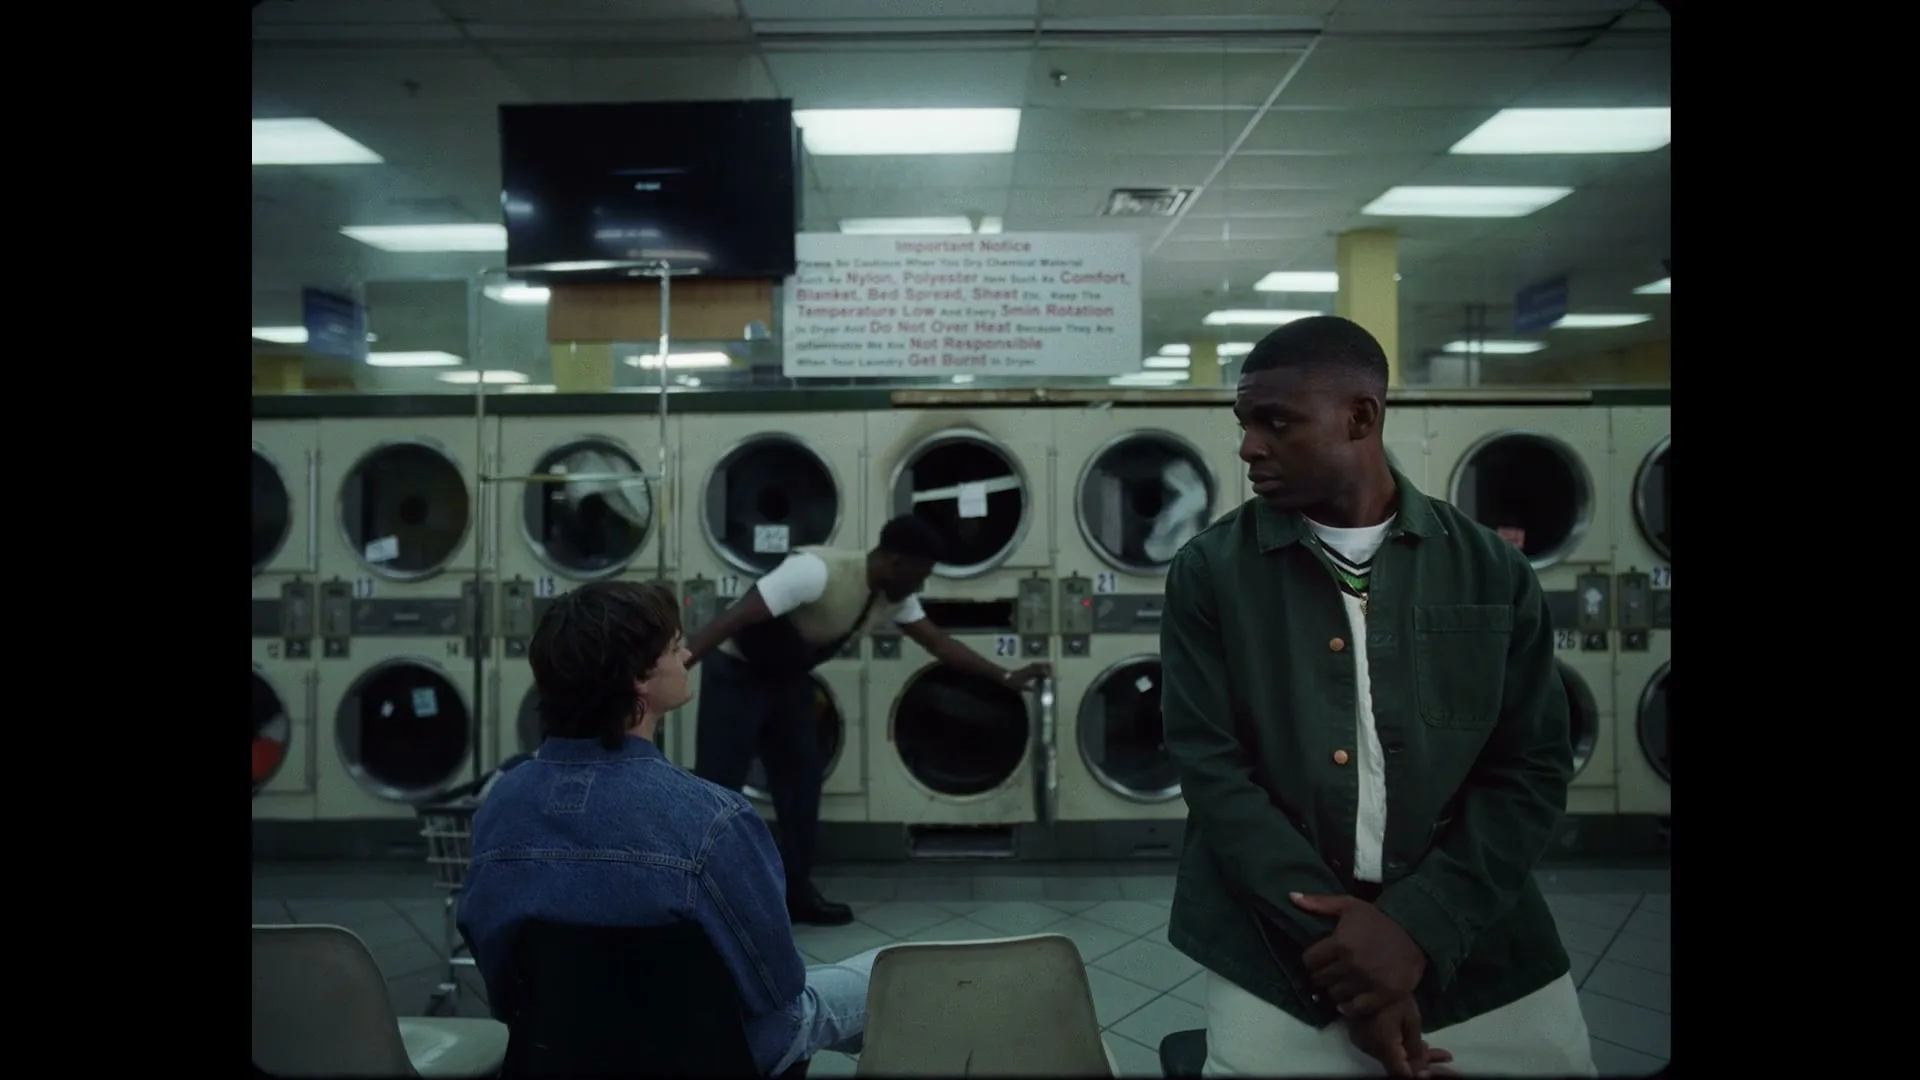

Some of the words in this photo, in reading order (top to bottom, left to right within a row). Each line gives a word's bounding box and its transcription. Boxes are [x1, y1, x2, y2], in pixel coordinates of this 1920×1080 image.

[894, 240, 972, 253] Important
[979, 240, 1031, 252] Notice
[905, 258, 934, 267] When
[939, 258, 960, 267] You
[963, 259, 982, 269] Dry
[986, 258, 1034, 267] Chemical
[1040, 258, 1083, 267] Material
[797, 275, 822, 284] Such
[903, 272, 977, 287] Polyester
[1010, 275, 1037, 284] Such
[1042, 276, 1054, 284] As
[1060, 270, 1131, 286] Comfort,
[868, 288, 898, 301] Bed
[973, 287, 1018, 300] Sheet
[1050, 291, 1076, 301] Keep
[1081, 290, 1102, 299] The
[797, 304, 895, 320] Temperature
[901, 304, 935, 317] Low
[940, 308, 962, 317] And
[965, 308, 996, 319] Every
[1045, 303, 1114, 317] Rotation
[795, 325, 806, 333] In
[810, 325, 841, 336] Dryer
[844, 325, 866, 333] And
[869, 320, 892, 334] Do
[897, 321, 925, 333] Not
[930, 320, 967, 333] Over
[973, 320, 1011, 333] Heat
[1016, 324, 1062, 333] Because
[1066, 324, 1091, 335] They
[1096, 325, 1114, 334] Are
[909, 337, 937, 350] Not
[943, 337, 1043, 352] Responsible
[831, 356, 856, 366] Your
[858, 357, 903, 368] Laundry
[907, 353, 936, 367] Get
[942, 353, 987, 367] Burnt
[990, 357, 1001, 366] In
[1005, 356, 1036, 368] Dryer
[540, 575, 555, 597] 15
[722, 576, 738, 596] 17
[1098, 572, 1116, 592] 21
[996, 636, 1017, 656] 20
[1557, 631, 1576, 650] 26
